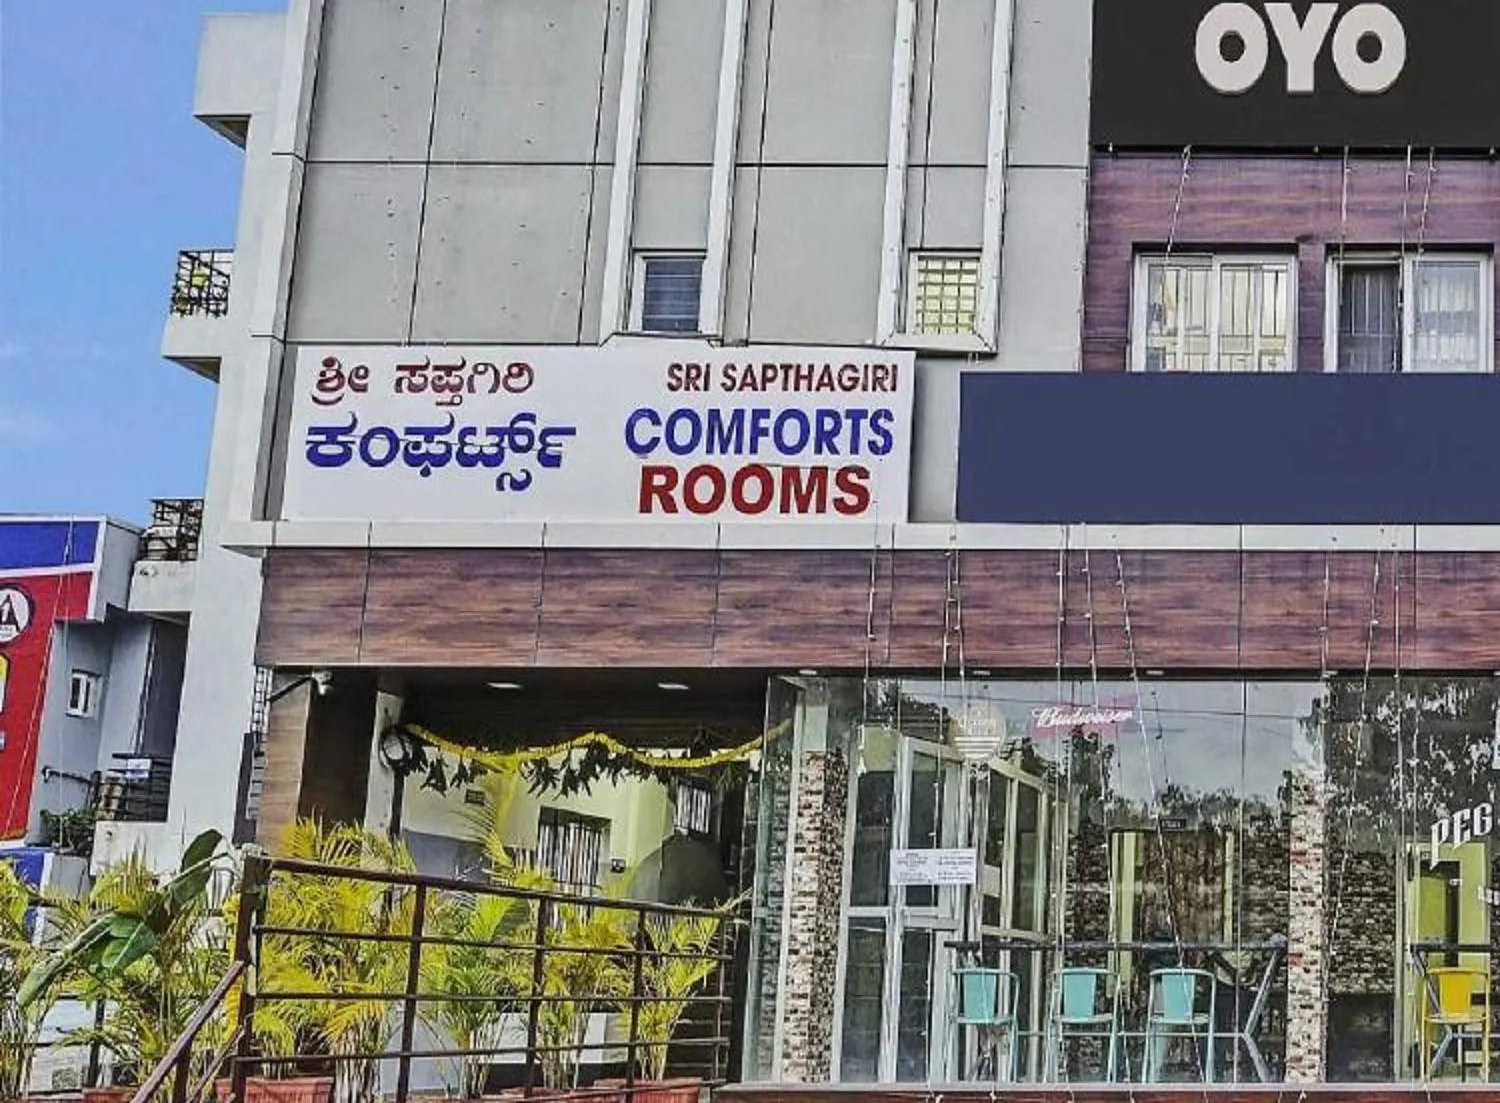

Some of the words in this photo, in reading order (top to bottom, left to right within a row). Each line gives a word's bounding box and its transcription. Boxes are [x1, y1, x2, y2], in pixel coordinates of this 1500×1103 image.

[1195, 2, 1406, 93] OYO
[311, 356, 369, 405] ಶ್ರೀ
[395, 356, 535, 406] ಸಪ್ತಗಿರಿ
[667, 363, 711, 392] SRI
[721, 363, 898, 393] SAPTHAGIRI
[625, 408, 894, 456] COMFORTS
[639, 464, 872, 514] ROOMS
[1429, 801, 1493, 871] PEG
